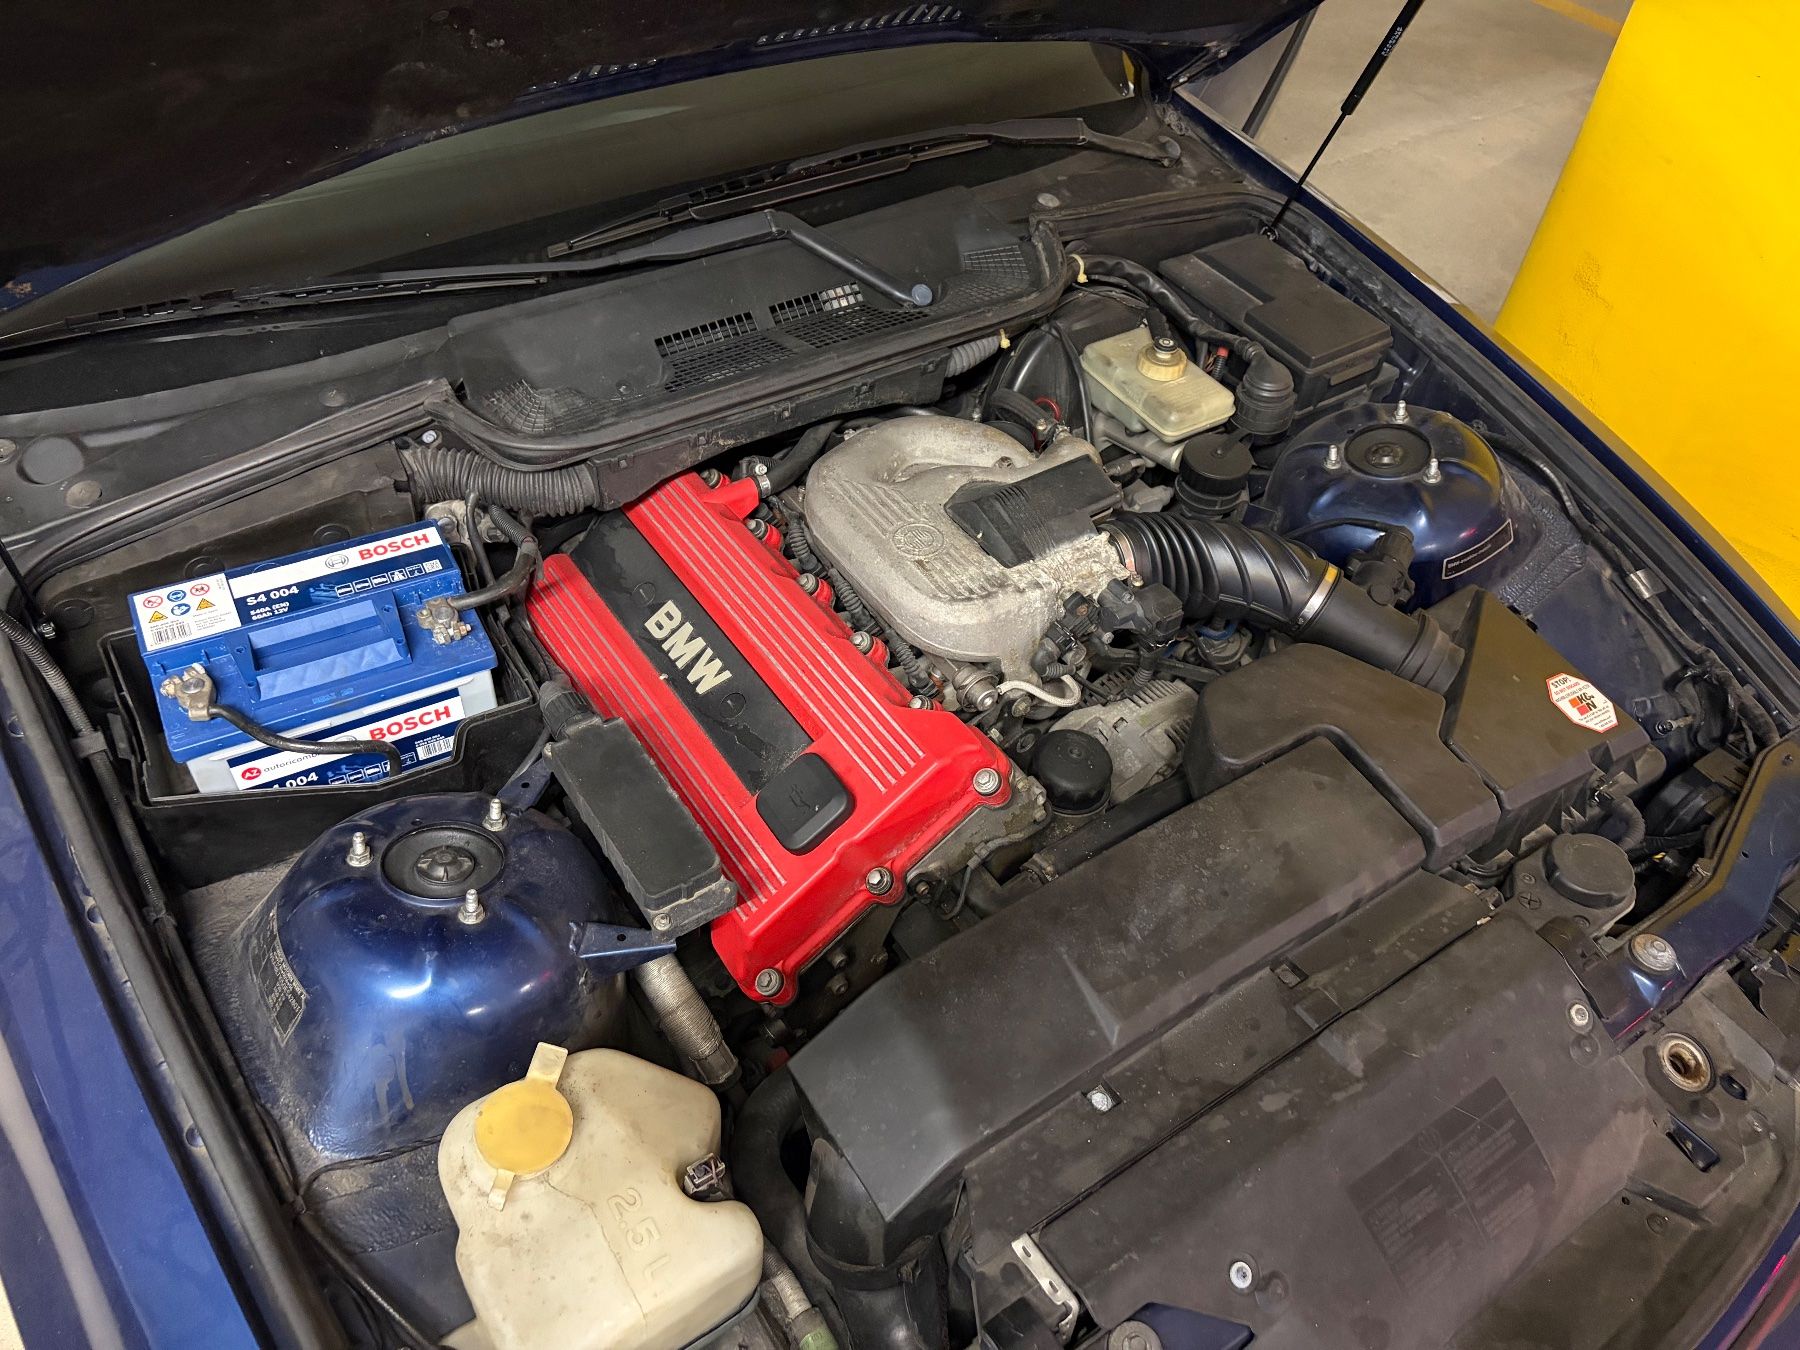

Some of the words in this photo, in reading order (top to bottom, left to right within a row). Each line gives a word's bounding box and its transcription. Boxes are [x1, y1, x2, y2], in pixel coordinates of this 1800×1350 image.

[358, 533, 430, 561] BOSCH
[246, 593, 267, 606] S4
[269, 585, 299, 599] 004
[643, 599, 733, 695] BMW
[369, 705, 451, 741] BOSCH
[244, 768, 262, 780] AZ
[263, 752, 320, 773] autoricamb
